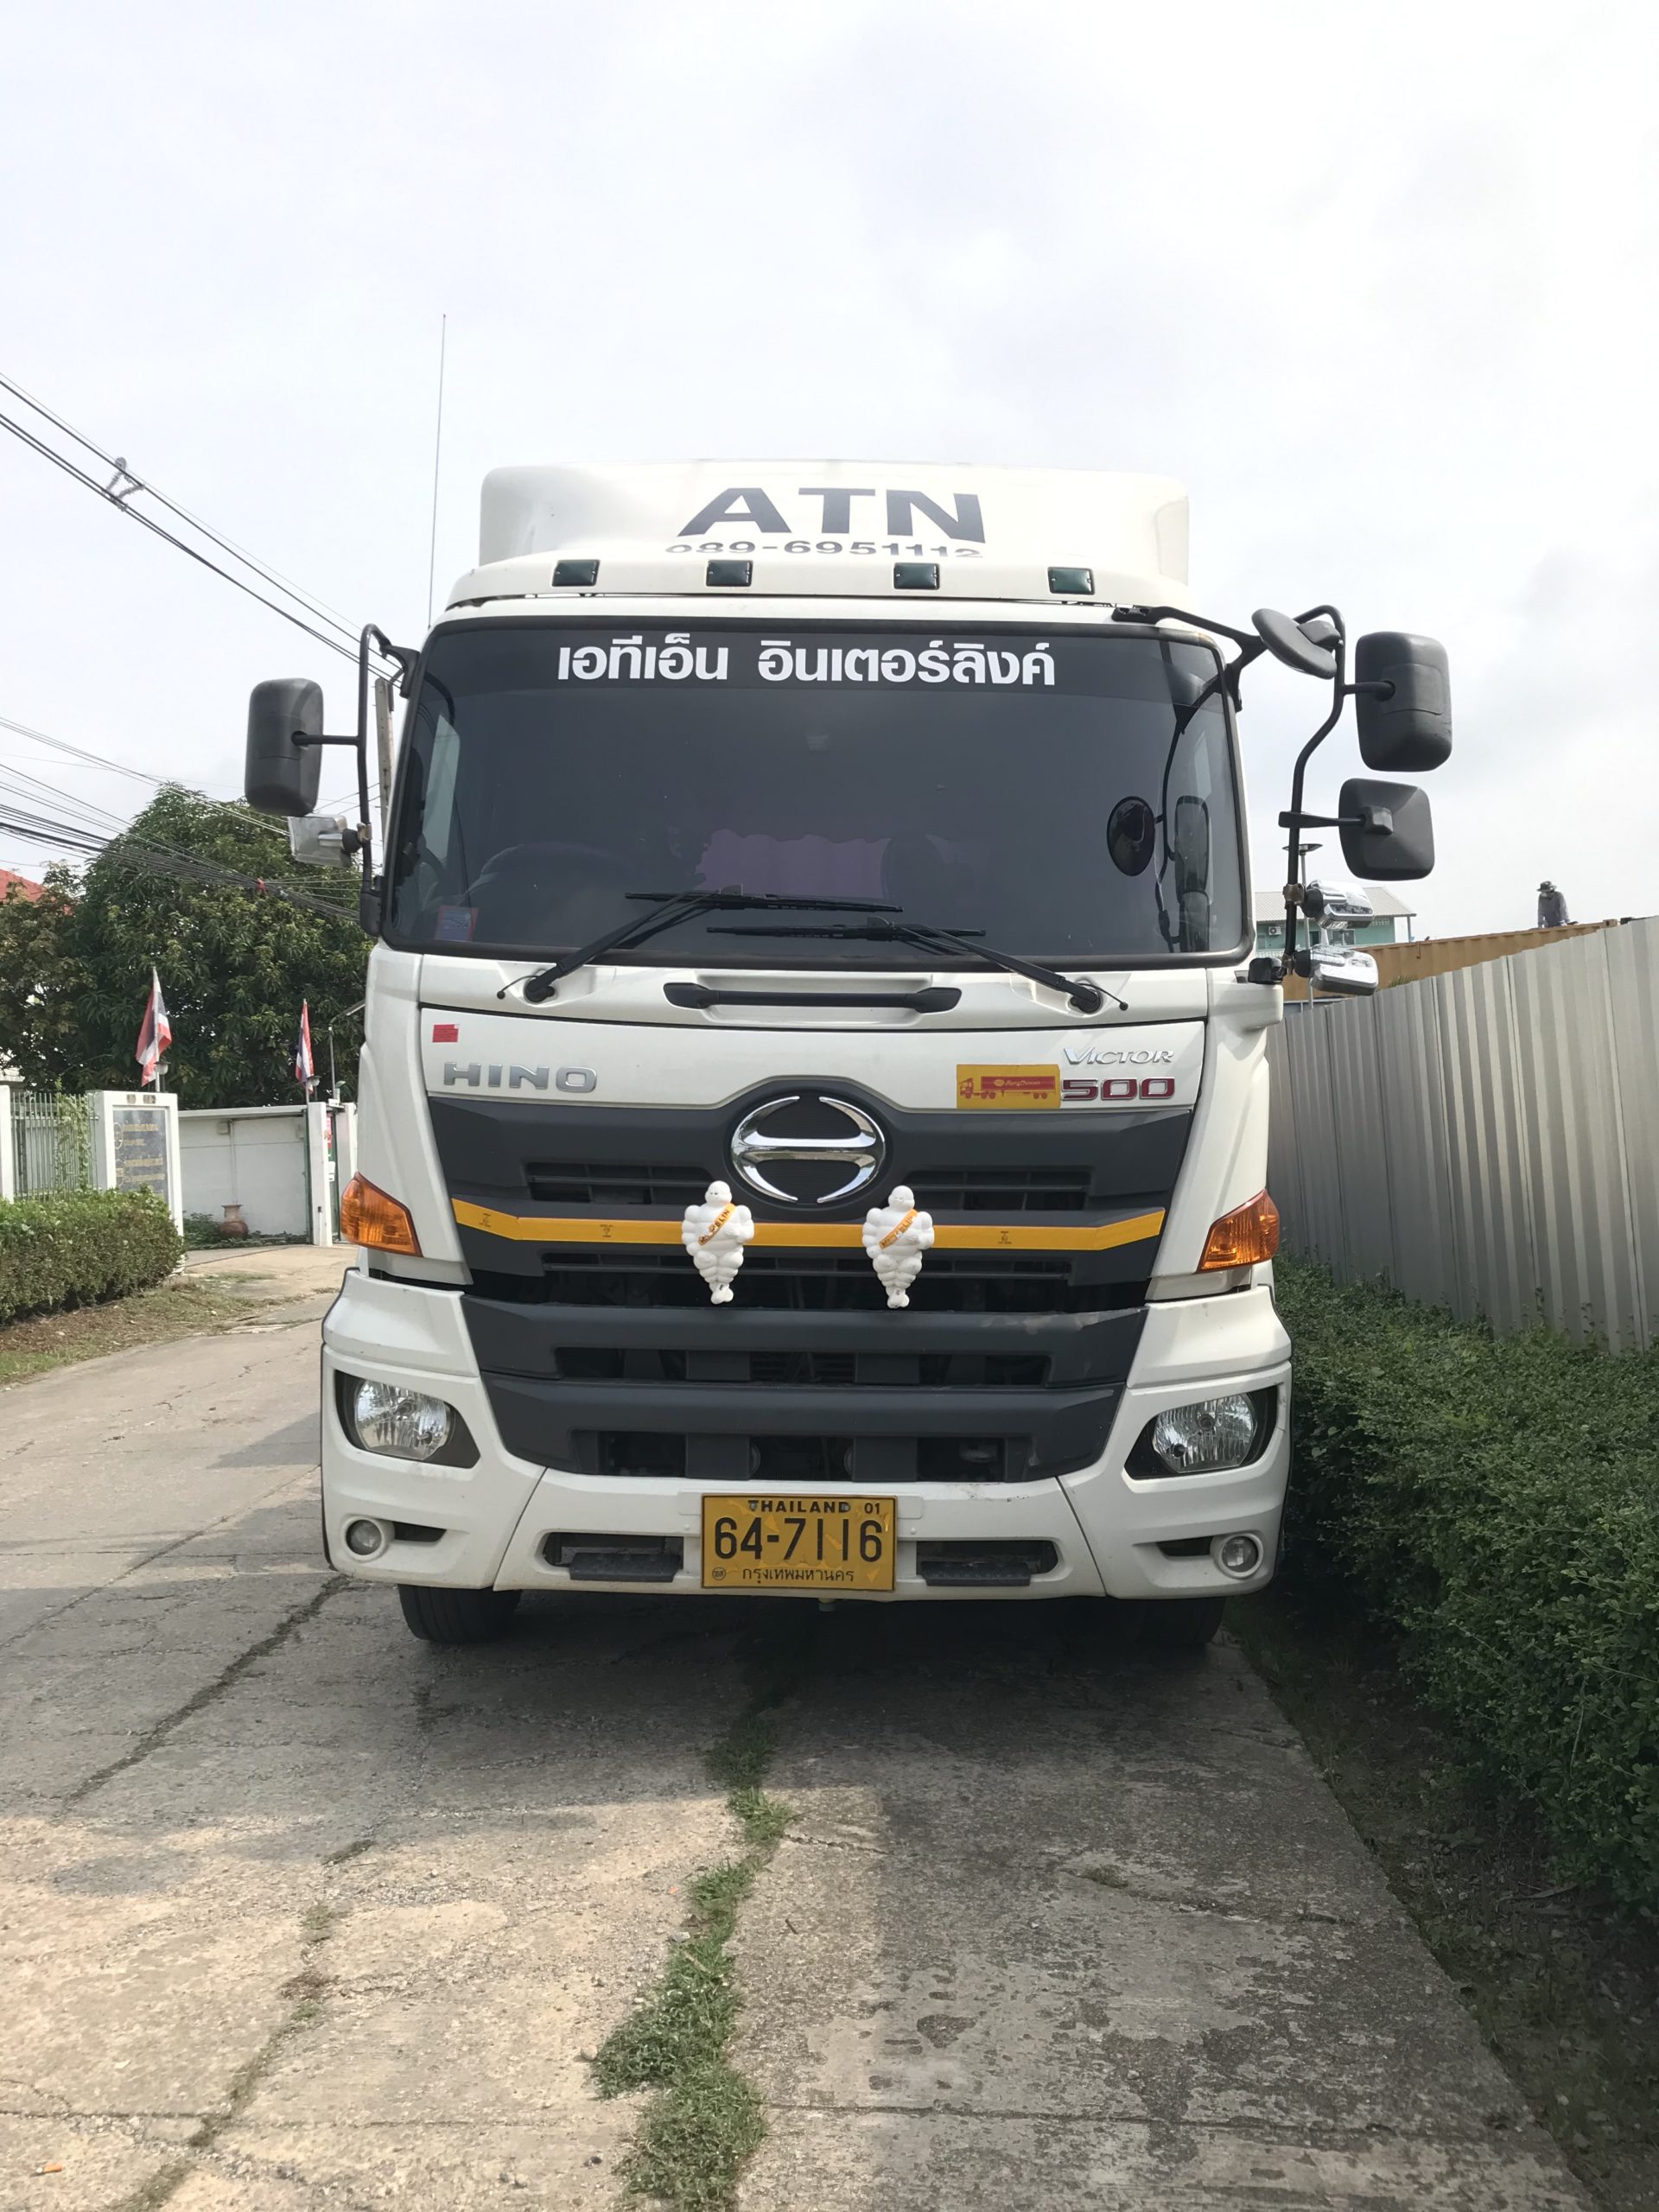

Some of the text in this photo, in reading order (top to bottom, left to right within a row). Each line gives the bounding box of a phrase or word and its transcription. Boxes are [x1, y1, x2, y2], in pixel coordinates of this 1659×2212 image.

[677, 487, 986, 543] ATN
[664, 540, 984, 558] 089-6951112
[557, 632, 1055, 686] เอทีเอ็น อินเตอร์ลิงค์
[1064, 1046, 1175, 1065] VICTOR
[443, 1061, 597, 1094] HINO
[1062, 1077, 1176, 1102] 500
[747, 1499, 880, 1515] THAILAND 01
[714, 1516, 883, 1563] 64-7116
[742, 1567, 855, 1585] กรุงเทพมหานคร
